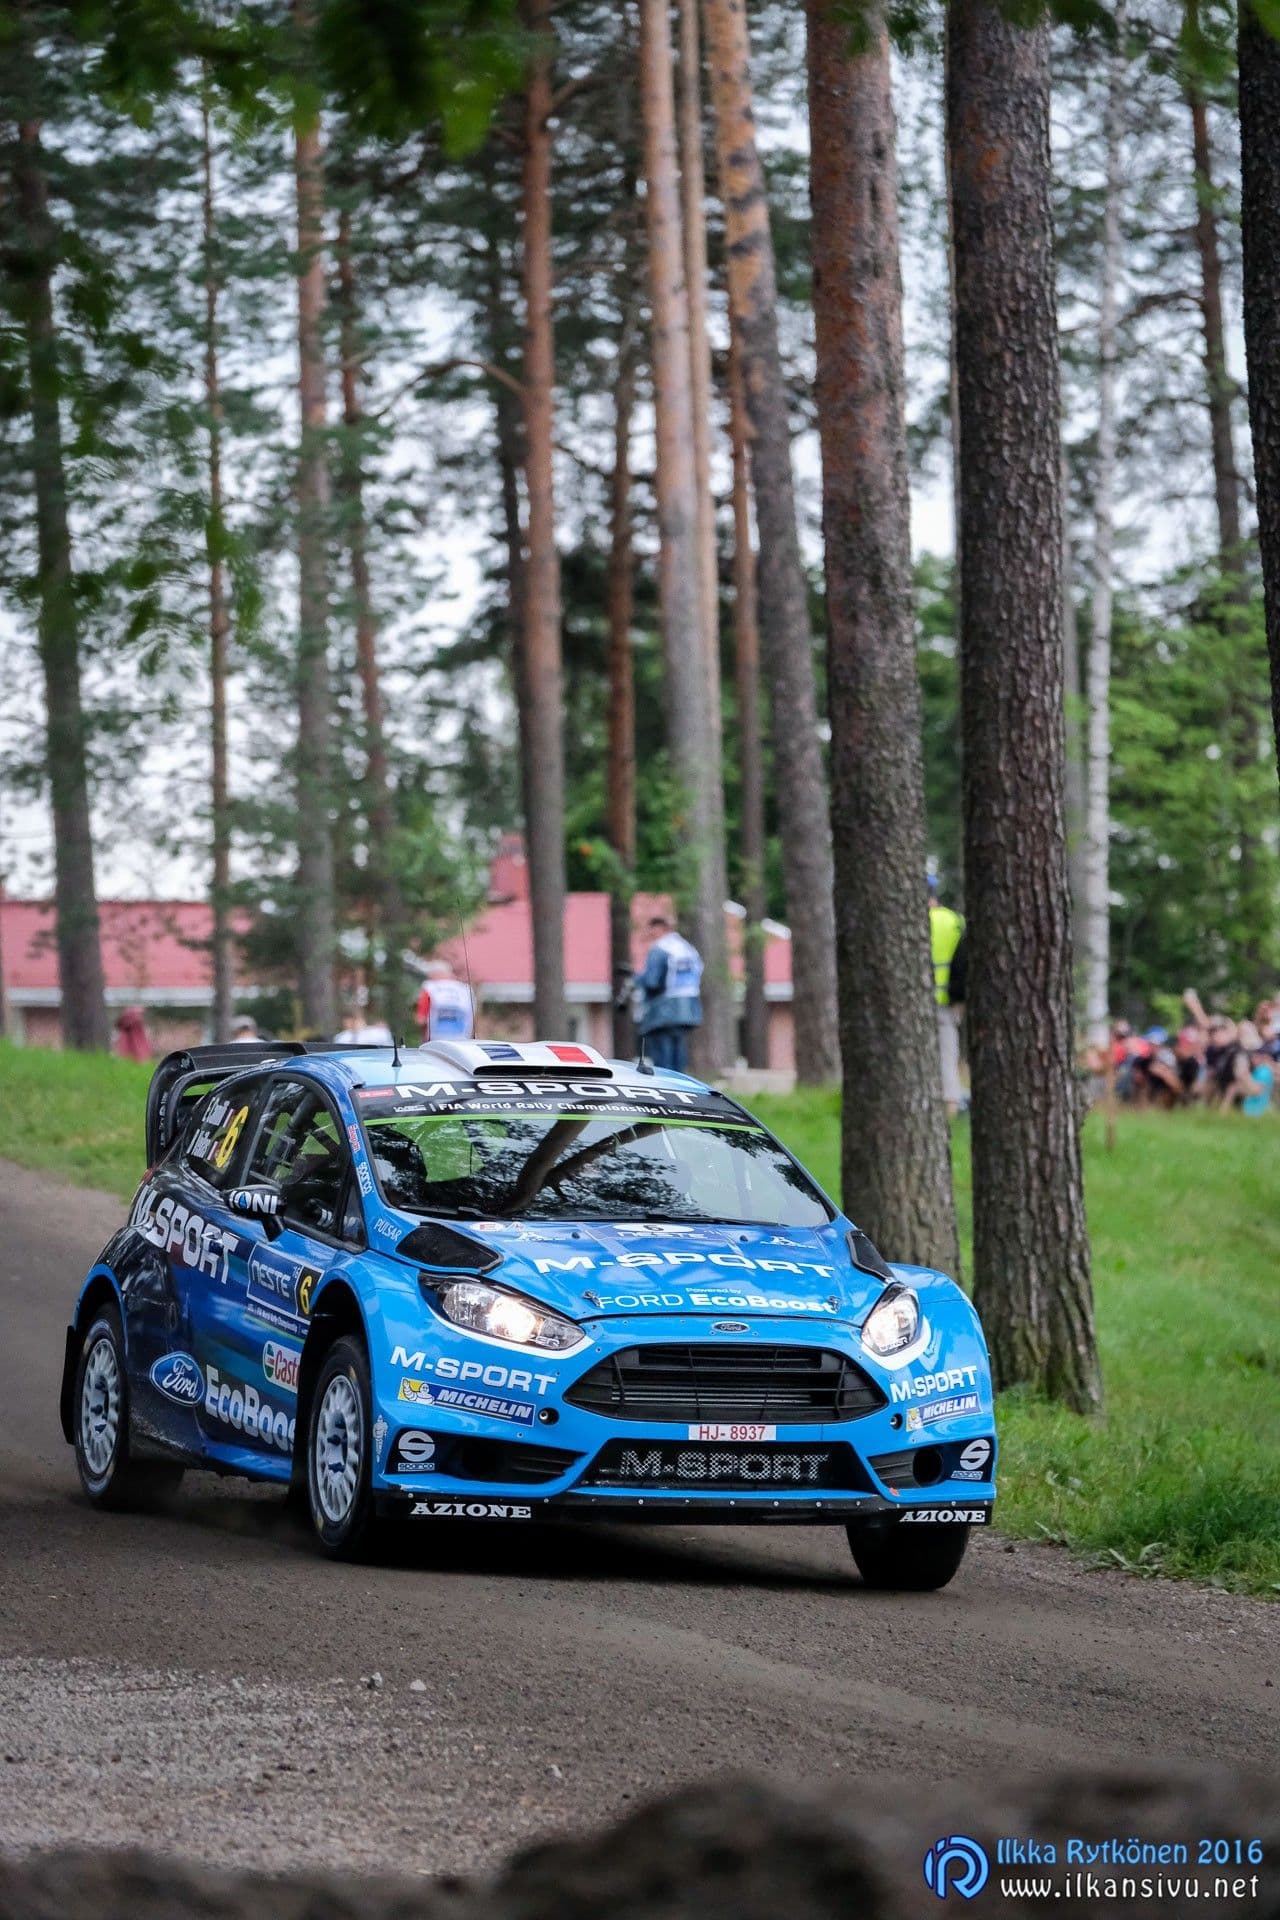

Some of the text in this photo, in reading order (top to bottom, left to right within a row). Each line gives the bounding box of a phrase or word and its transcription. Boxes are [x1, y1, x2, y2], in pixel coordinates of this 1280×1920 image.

[395, 1081, 698, 1104] M-SPORT
[439, 1103, 465, 1111] FIA
[468, 1102, 513, 1110] World
[516, 1102, 553, 1111] Rally
[557, 1102, 659, 1115] Championship
[216, 1105, 249, 1168] 6
[374, 1218, 402, 1241] PULSAR
[643, 1224, 664, 1232] 6
[533, 1252, 836, 1278] M-SPORT
[251, 1260, 291, 1298] NESTE
[300, 1274, 313, 1315] 6
[598, 1293, 838, 1314] FORD EcoBoost
[720, 1322, 743, 1332] Ford
[162, 1359, 199, 1399] Ford
[437, 1388, 533, 1419] MICHELIN
[922, 1395, 977, 1420] MICHELIN
[730, 1425, 766, 1440] 8937
[410, 1502, 532, 1519] AZIONE
[900, 1509, 986, 1524] AZIONE
